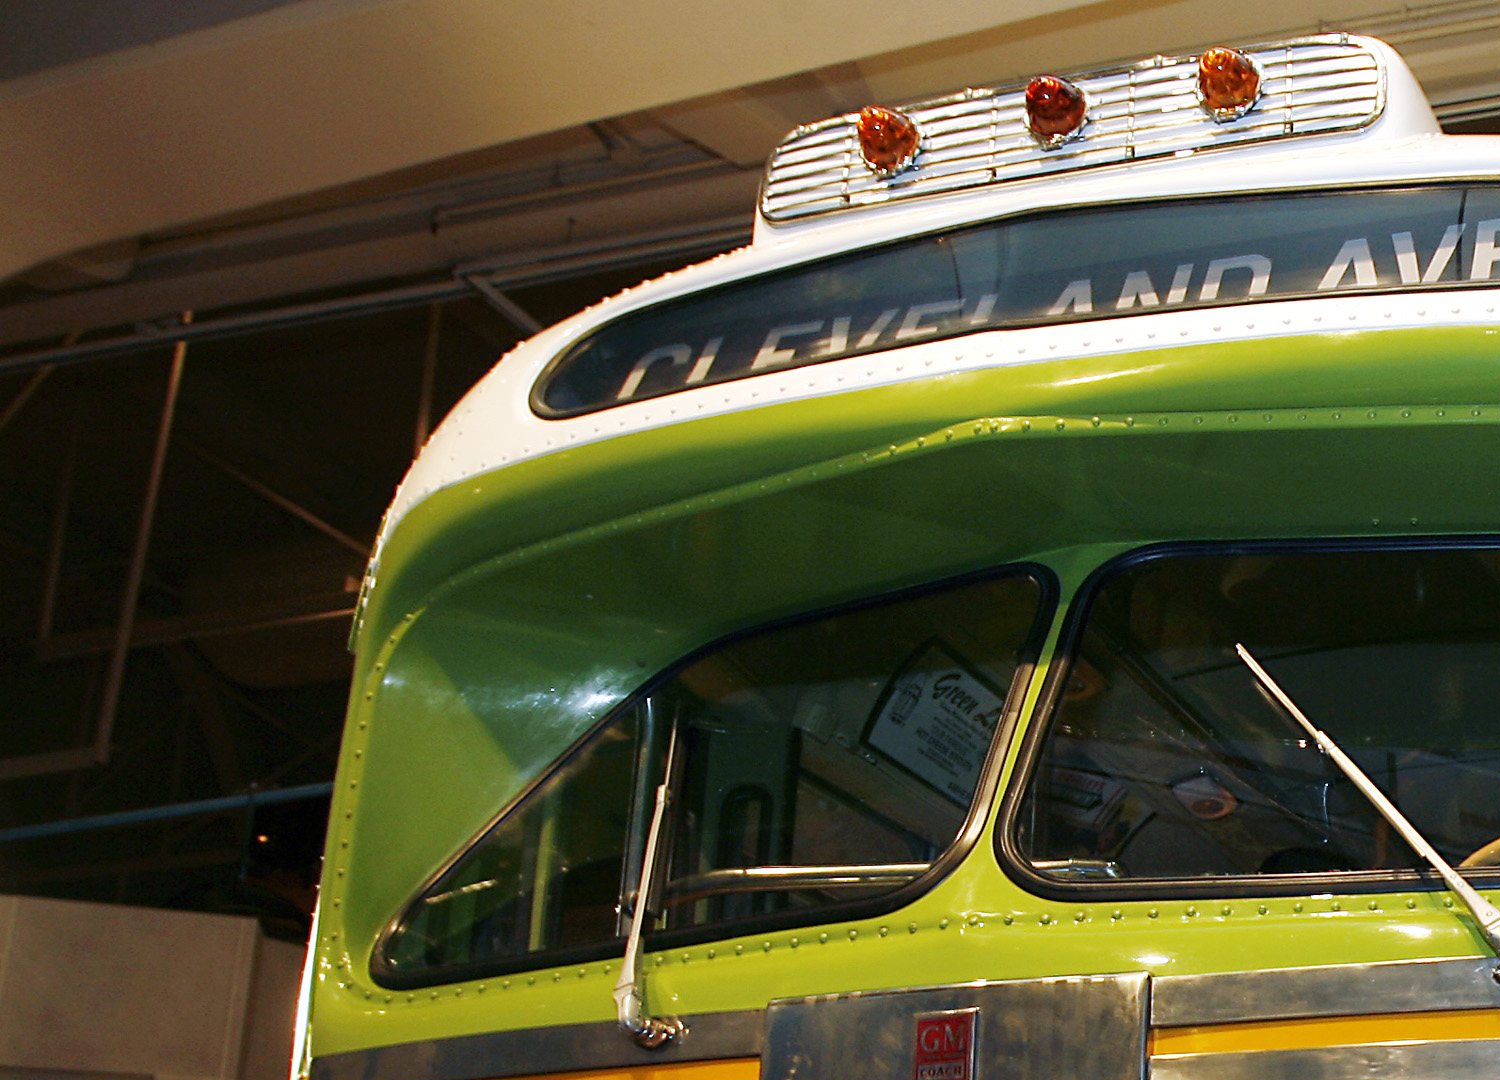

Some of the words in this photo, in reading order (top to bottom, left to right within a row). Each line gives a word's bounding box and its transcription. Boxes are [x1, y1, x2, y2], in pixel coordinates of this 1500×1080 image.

[932, 674, 979, 715] Green
[920, 1023, 964, 1052] GM
[920, 1064, 963, 1079] COACH
